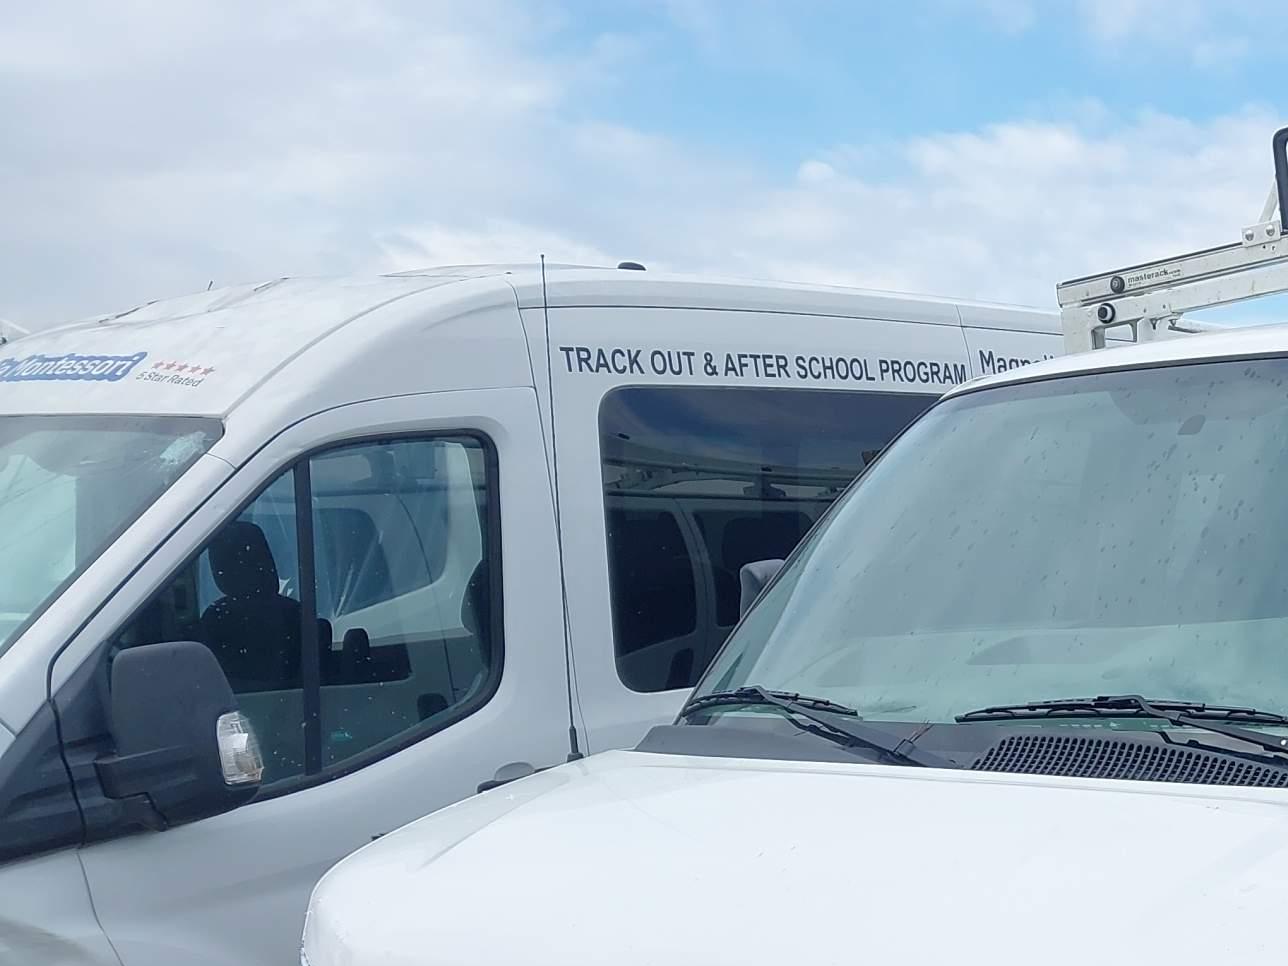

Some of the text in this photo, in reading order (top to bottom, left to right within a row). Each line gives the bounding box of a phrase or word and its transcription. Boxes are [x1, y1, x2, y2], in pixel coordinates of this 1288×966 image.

[14, 355, 140, 378] Montessori
[559, 346, 967, 385] TRACK OUT & AFTER SCHOOL PROGRAM
[135, 371, 205, 388] 5 Star Rated
